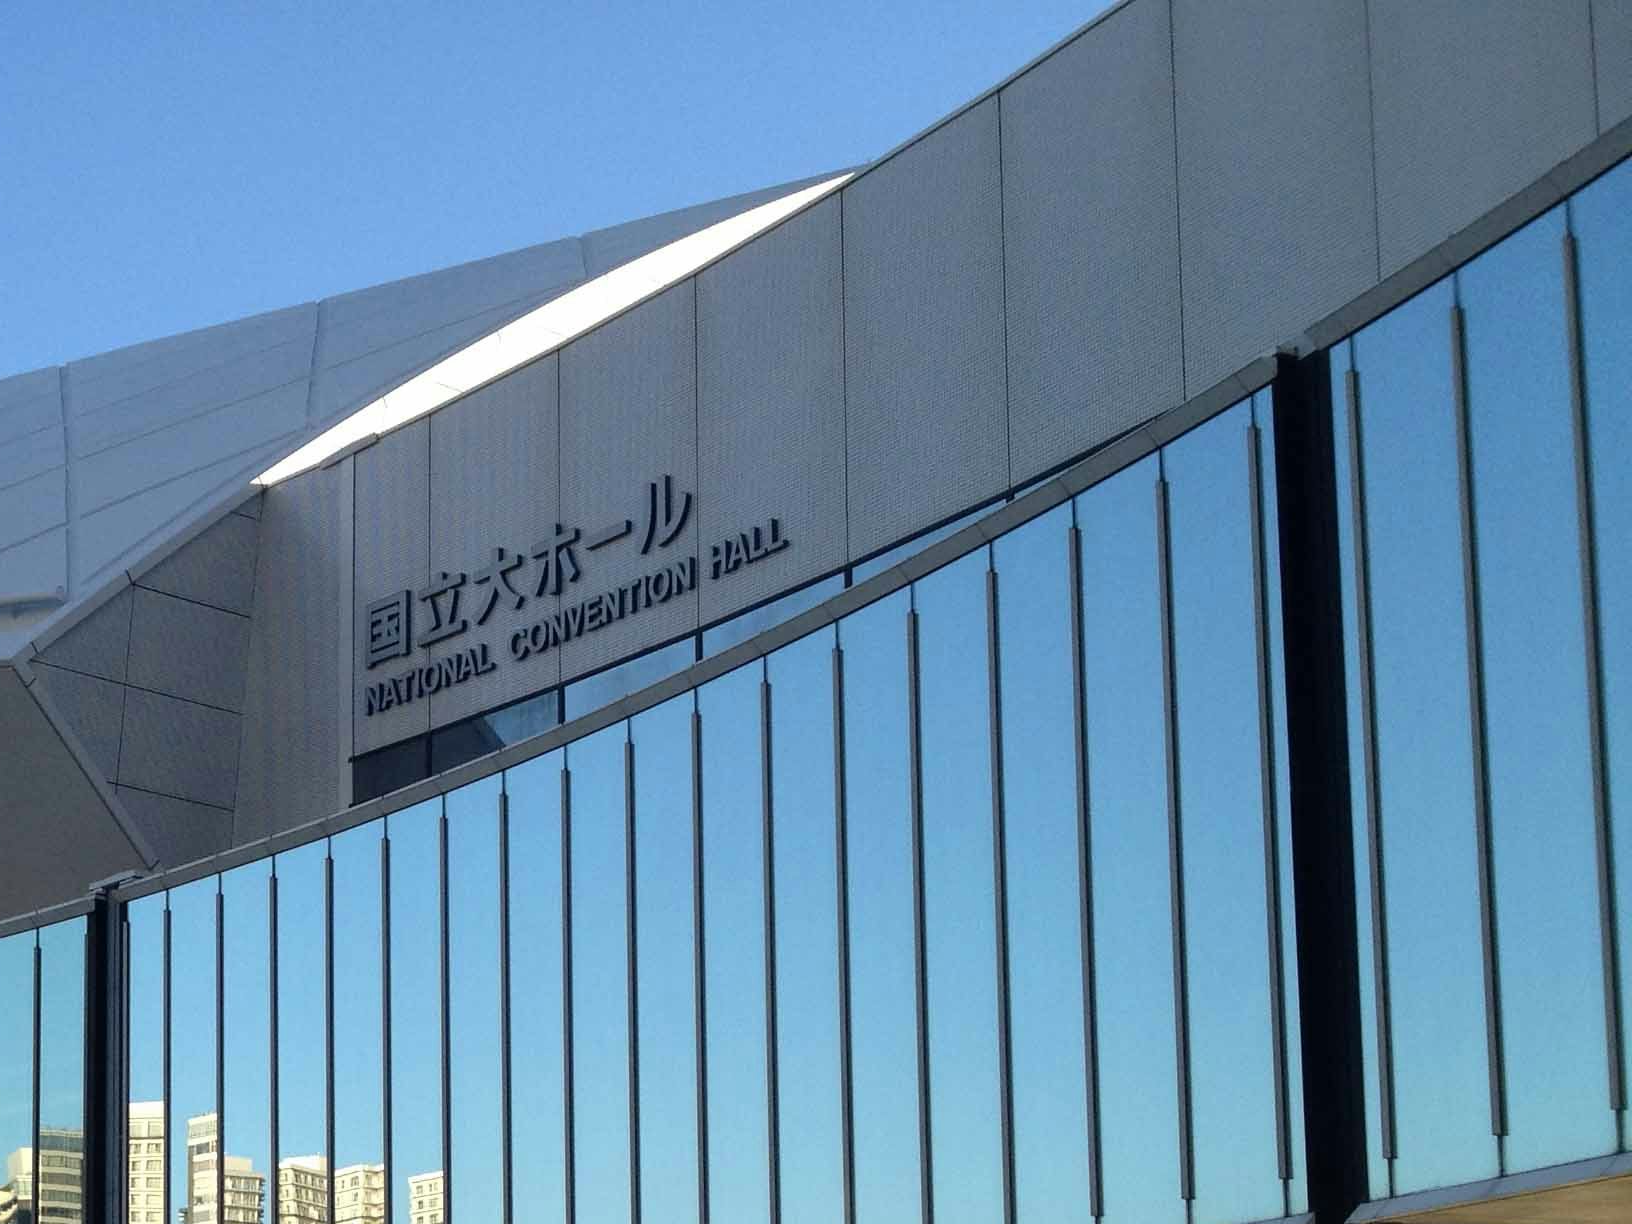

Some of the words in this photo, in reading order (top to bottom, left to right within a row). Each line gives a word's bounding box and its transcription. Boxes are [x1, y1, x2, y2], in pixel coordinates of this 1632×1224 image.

[366, 642, 497, 717] NATIONAL
[510, 555, 697, 662] CONVENTION
[709, 518, 791, 580] HALL
[367, 474, 693, 669] 国立大ホール
